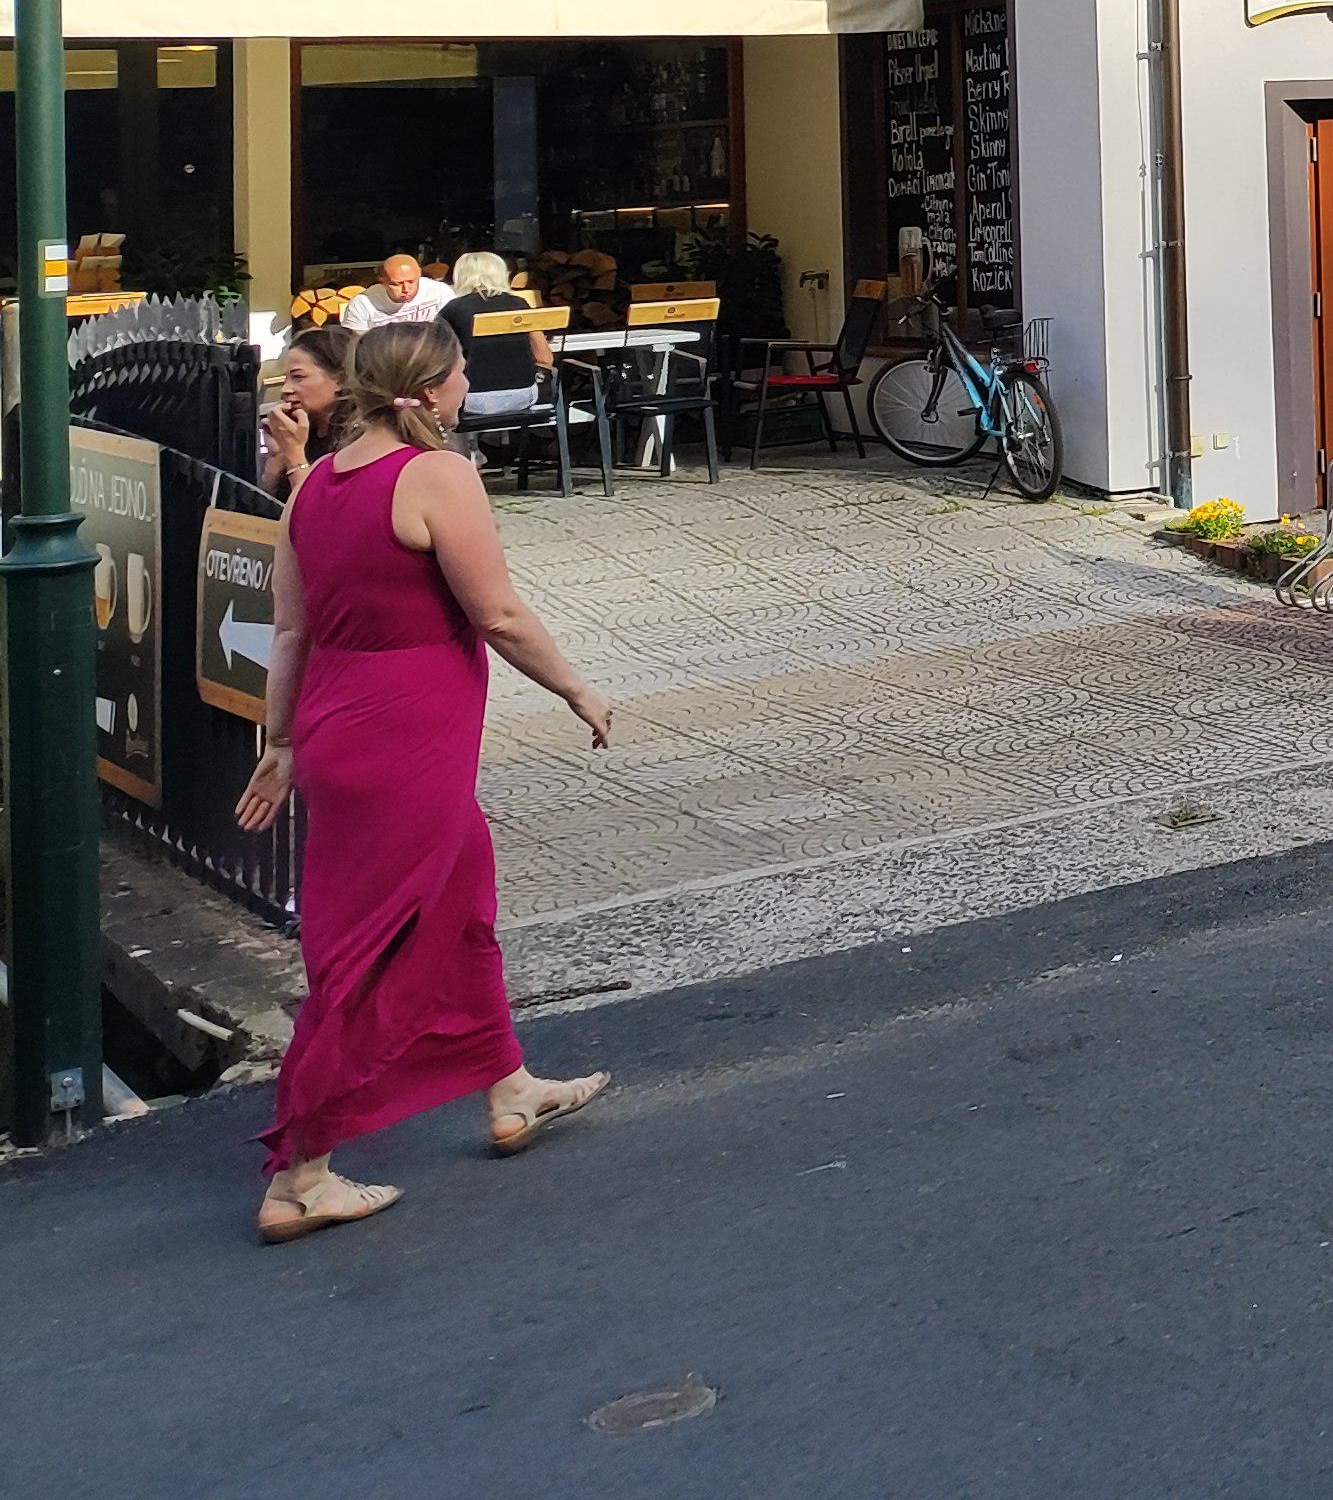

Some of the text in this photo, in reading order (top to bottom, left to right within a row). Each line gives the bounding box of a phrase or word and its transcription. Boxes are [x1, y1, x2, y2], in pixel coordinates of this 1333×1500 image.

[966, 78, 1001, 102] Berry
[968, 102, 1009, 132] Skinny
[971, 132, 1006, 160] Skinny
[969, 191, 1007, 231] Aperol
